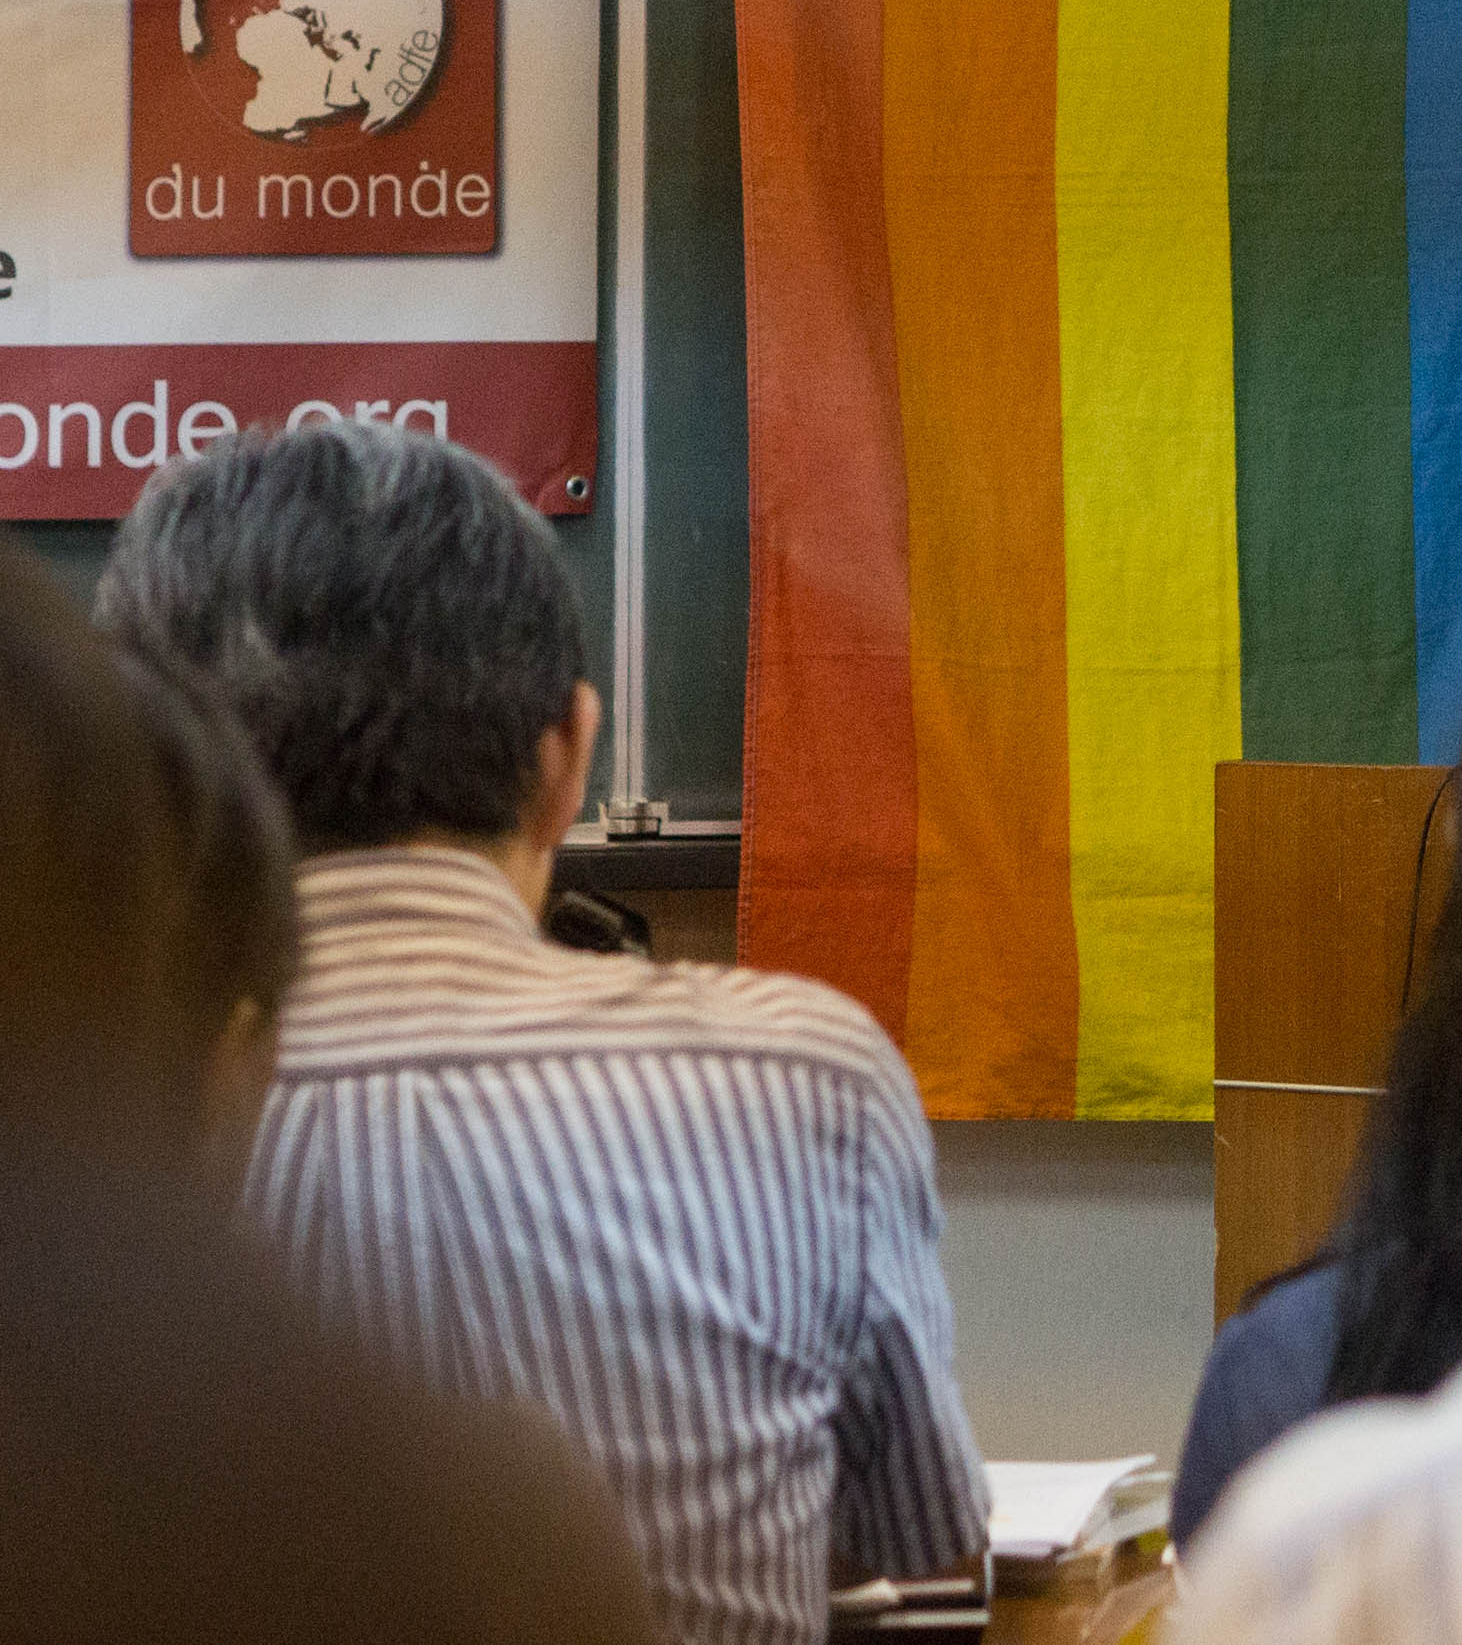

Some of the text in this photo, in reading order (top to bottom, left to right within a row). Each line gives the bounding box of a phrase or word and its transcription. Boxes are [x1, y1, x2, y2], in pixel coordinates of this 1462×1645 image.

[384, 29, 440, 107] adfe
[145, 161, 491, 222] du monde
[0, 379, 449, 470] onde
